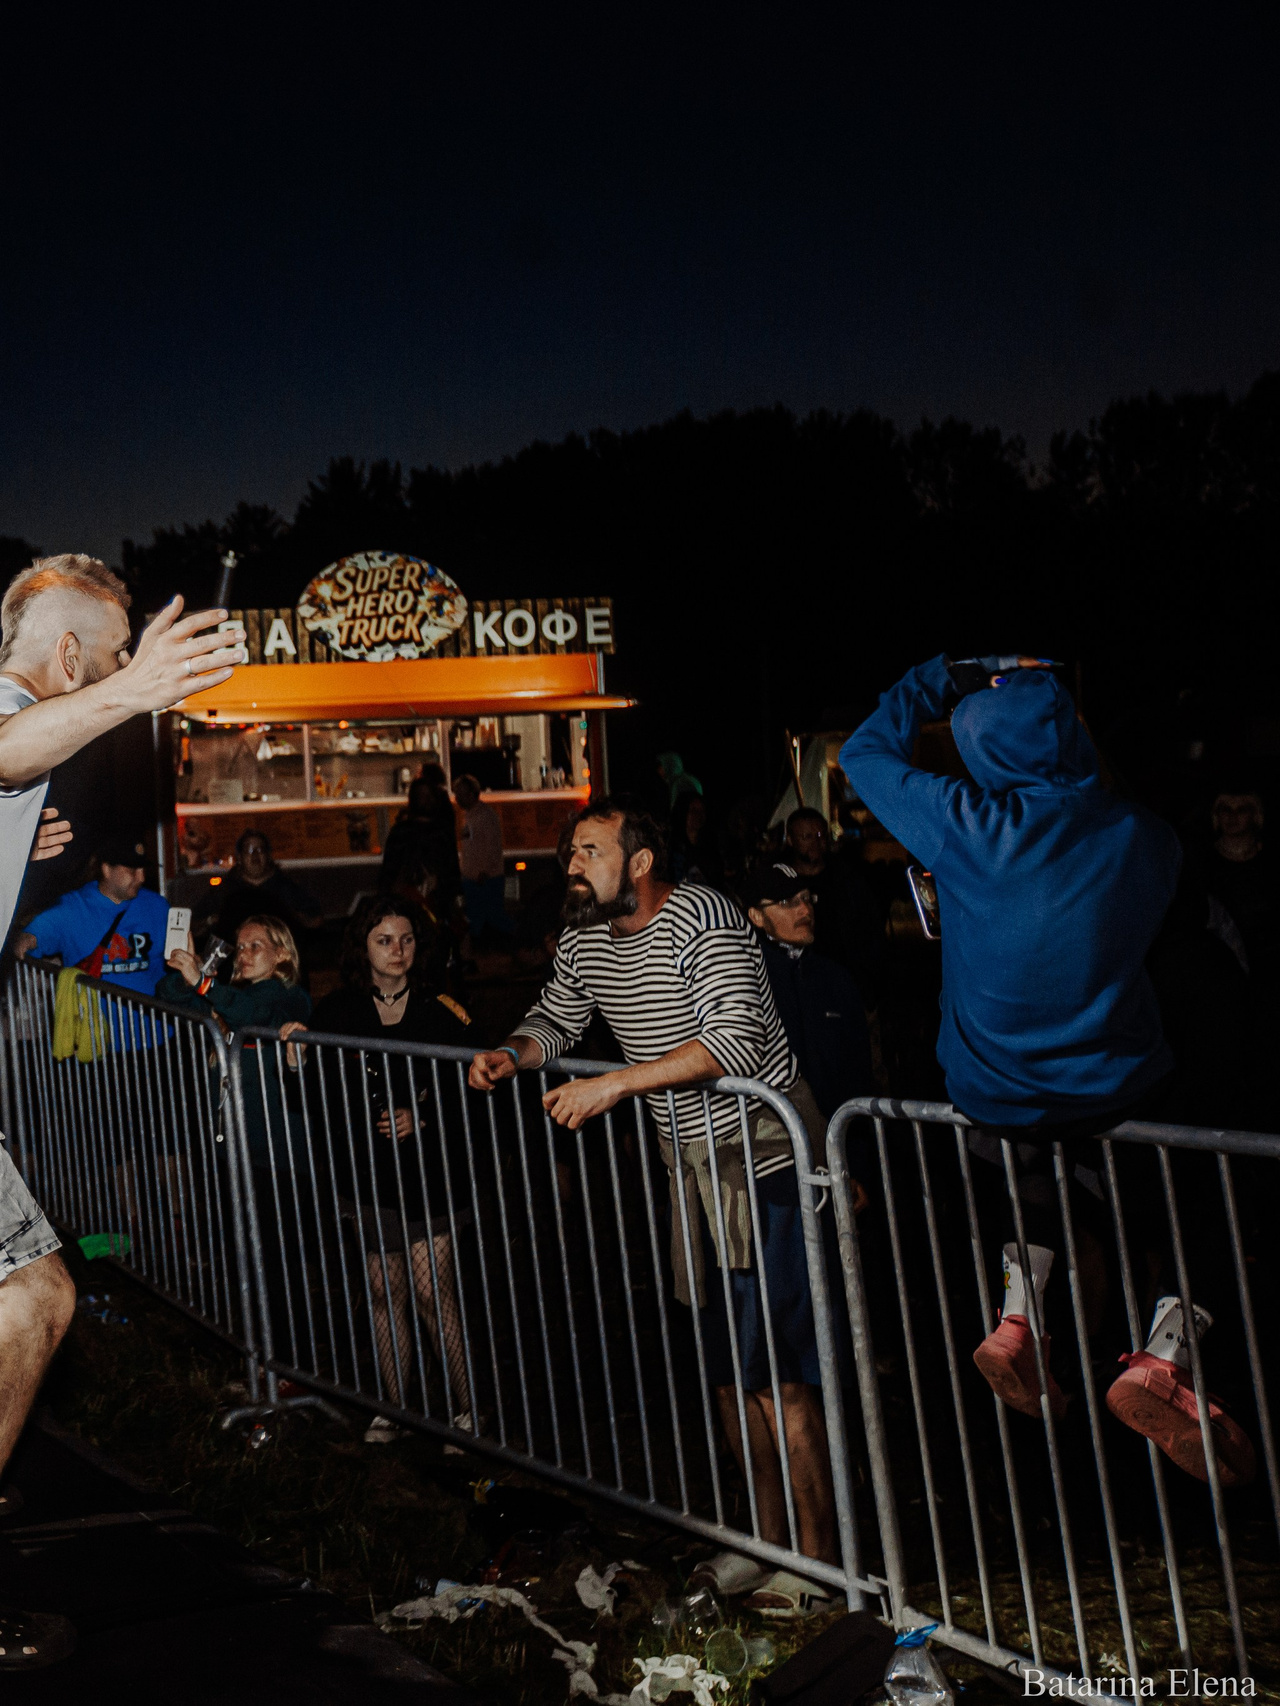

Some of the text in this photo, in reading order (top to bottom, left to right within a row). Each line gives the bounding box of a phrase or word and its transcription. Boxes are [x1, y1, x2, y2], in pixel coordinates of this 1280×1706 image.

[331, 563, 421, 601] SUPER
[346, 590, 415, 618] HERO
[338, 613, 424, 648] TRUCK
[473, 607, 613, 649] КОФЕ
